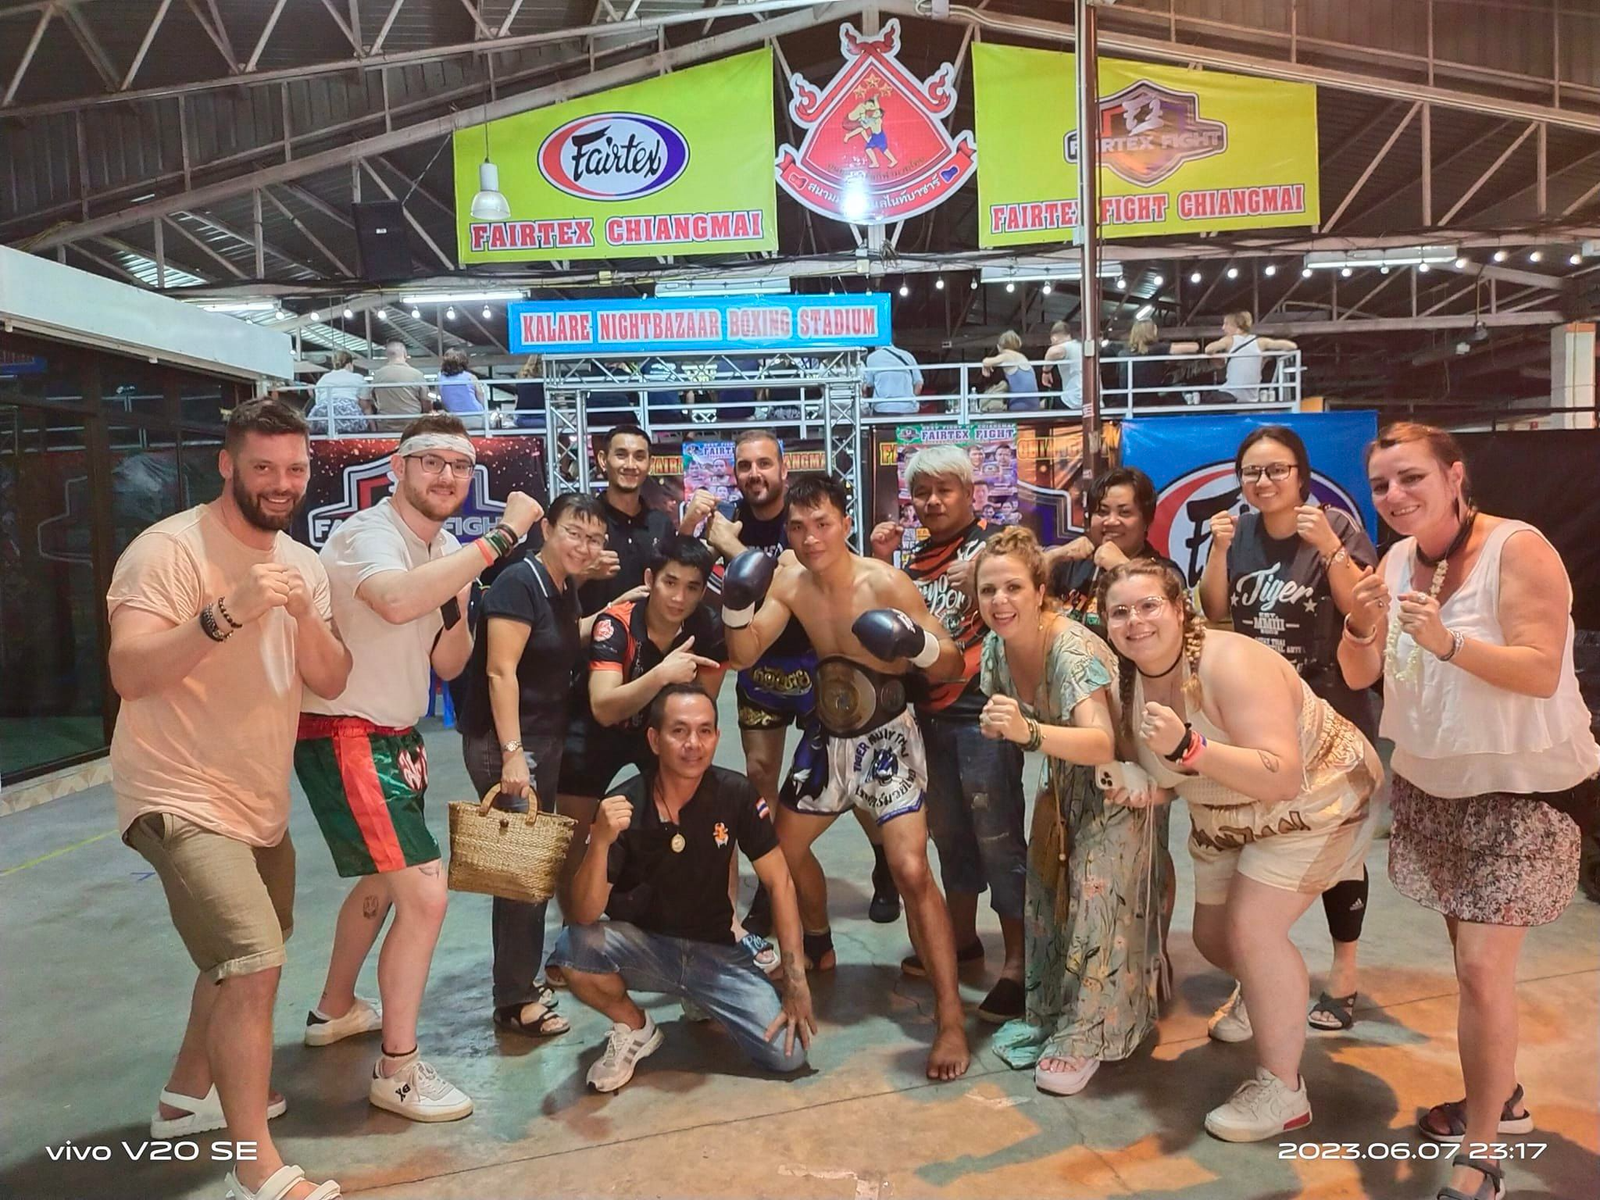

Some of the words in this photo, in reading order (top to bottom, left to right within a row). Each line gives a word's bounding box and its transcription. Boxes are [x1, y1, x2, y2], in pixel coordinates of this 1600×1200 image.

[571, 125, 661, 182] Fairtex
[1070, 135, 1155, 155] FIRTEX
[1161, 130, 1221, 149] FIGHT
[1101, 195, 1167, 224] FIGHT
[1179, 185, 1304, 219] CHIANGMAI
[471, 220, 593, 250] FAIRTEX
[606, 211, 762, 245] CHIANGMAI
[523, 314, 590, 342] KALARE
[600, 311, 719, 340] NIGHTBAZAAR
[729, 309, 791, 339] BOXING
[799, 308, 876, 336] STADIUM
[921, 430, 970, 440] FAIRTEX
[975, 429, 1015, 439] FIGHT
[444, 516, 503, 537] FIGH
[1236, 562, 1314, 611] Tiger
